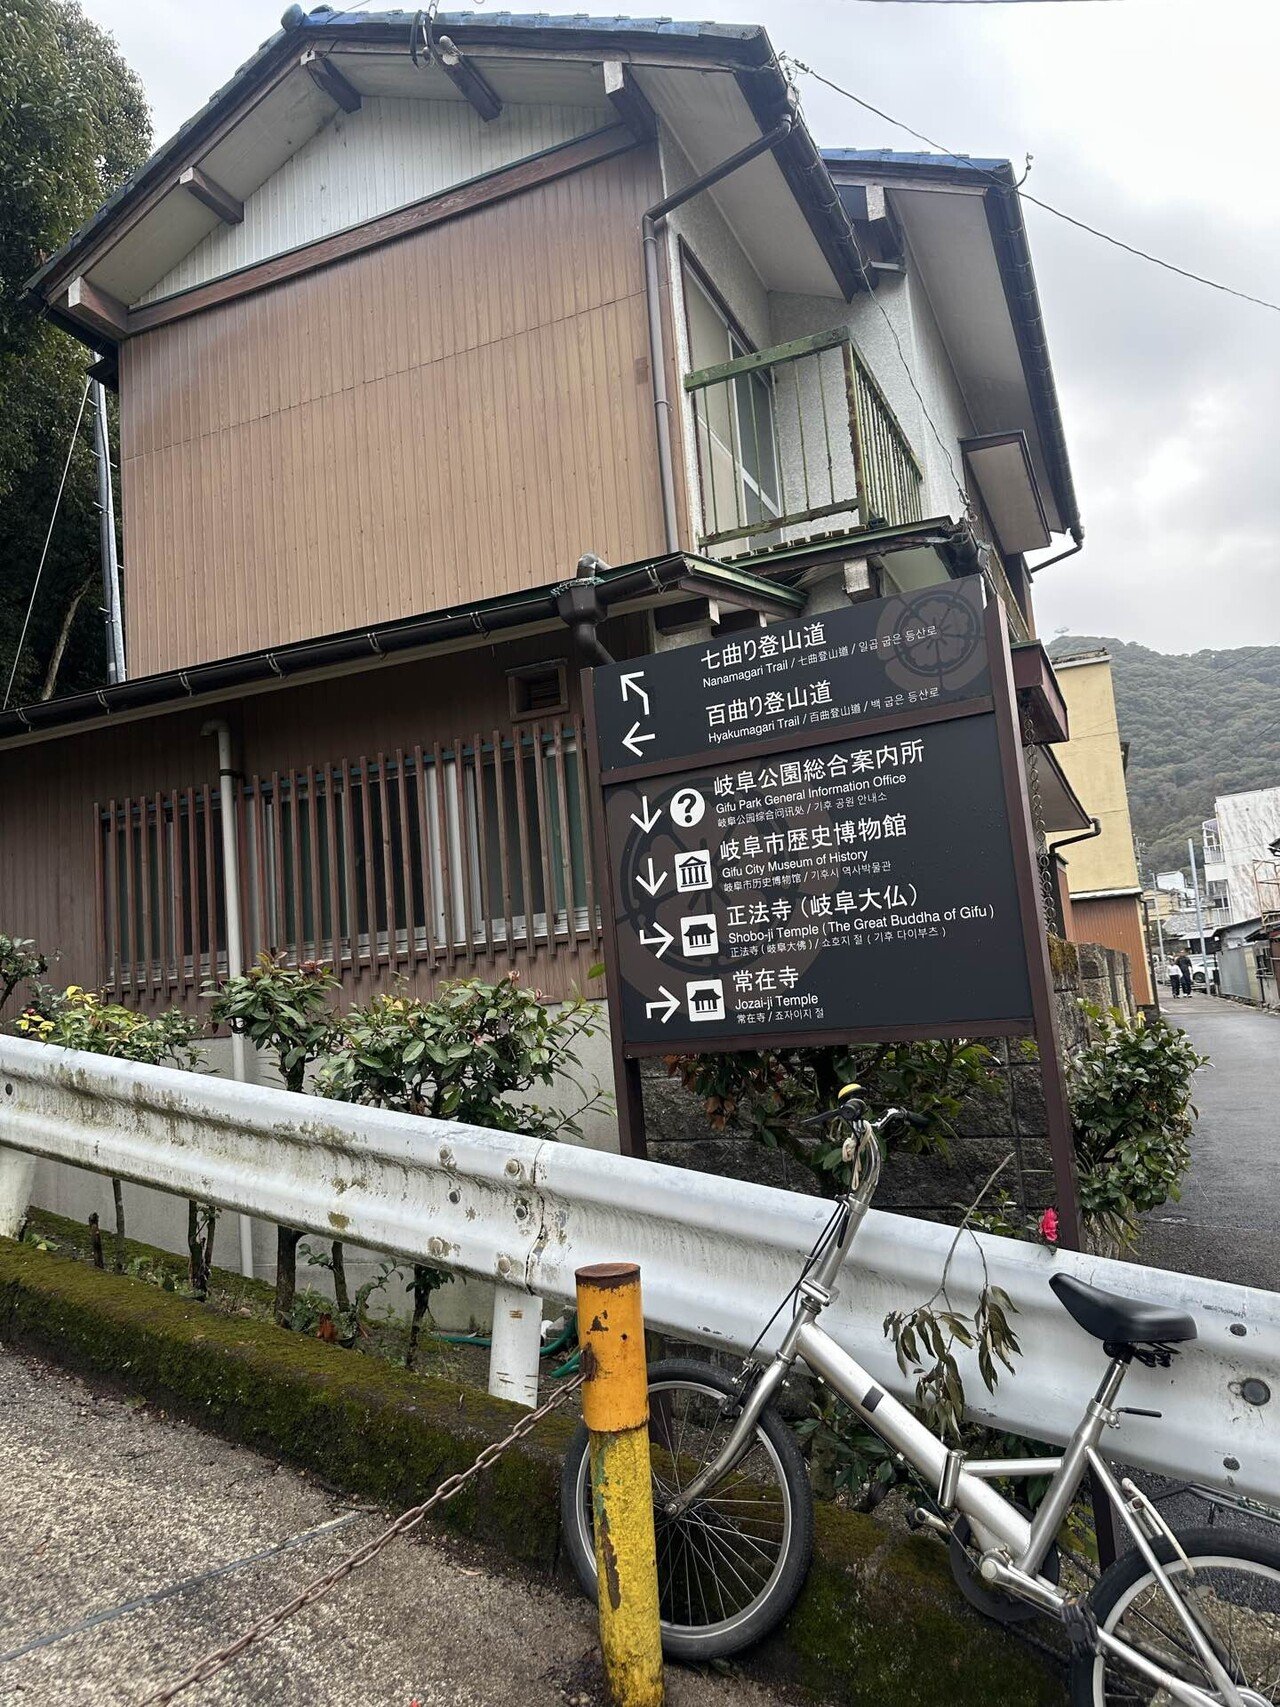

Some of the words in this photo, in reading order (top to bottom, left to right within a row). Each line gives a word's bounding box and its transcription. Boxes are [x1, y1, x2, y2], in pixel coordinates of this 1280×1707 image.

[701, 621, 827, 670] 七曲り登山道
[702, 665, 764, 688] Nanamagari
[765, 659, 788, 674] Trail
[798, 645, 850, 666] 七曲登山道
[858, 638, 879, 653] 일곱
[881, 633, 903, 648] 굽은
[904, 625, 938, 642] 등산로
[705, 679, 833, 727] 百曲り登山道
[708, 720, 775, 744] Hyakumagari
[777, 715, 800, 730] Trail
[809, 702, 861, 723] 百曲登山道
[870, 698, 881, 710] 백
[884, 693, 905, 708] 굽은
[907, 686, 940, 703] 등산로
[713, 738, 925, 797] 岐阜公園総合案内所
[715, 802, 737, 814] Gifu
[739, 797, 763, 810] Park
[764, 789, 806, 805] General
[808, 780, 871, 799] Information
[872, 774, 907, 788] Office
[814, 799, 832, 812] 기후
[835, 795, 855, 809] 공원
[857, 791, 888, 806] 안내소
[720, 812, 908, 862] 岐阜市歴史博物館
[722, 868, 743, 879] Gifu
[745, 862, 766, 877] City
[767, 857, 814, 872] Museum
[815, 853, 827, 866] of
[829, 850, 869, 864] History
[811, 867, 840, 881] 기후시
[842, 860, 892, 877] 역사박물관
[728, 928, 774, 944] Shobo-ji
[776, 924, 819, 939] Temple
[853, 916, 888, 930] Great
[890, 911, 941, 927] Buddha
[943, 908, 957, 921] of
[853, 934, 863, 946] 절
[732, 965, 799, 993] 常在寺
[734, 996, 773, 1011] Jozai-ji
[774, 992, 819, 1007] Temple
[736, 1011, 767, 1025] 常在寺
[814, 1007, 824, 1019] 절
